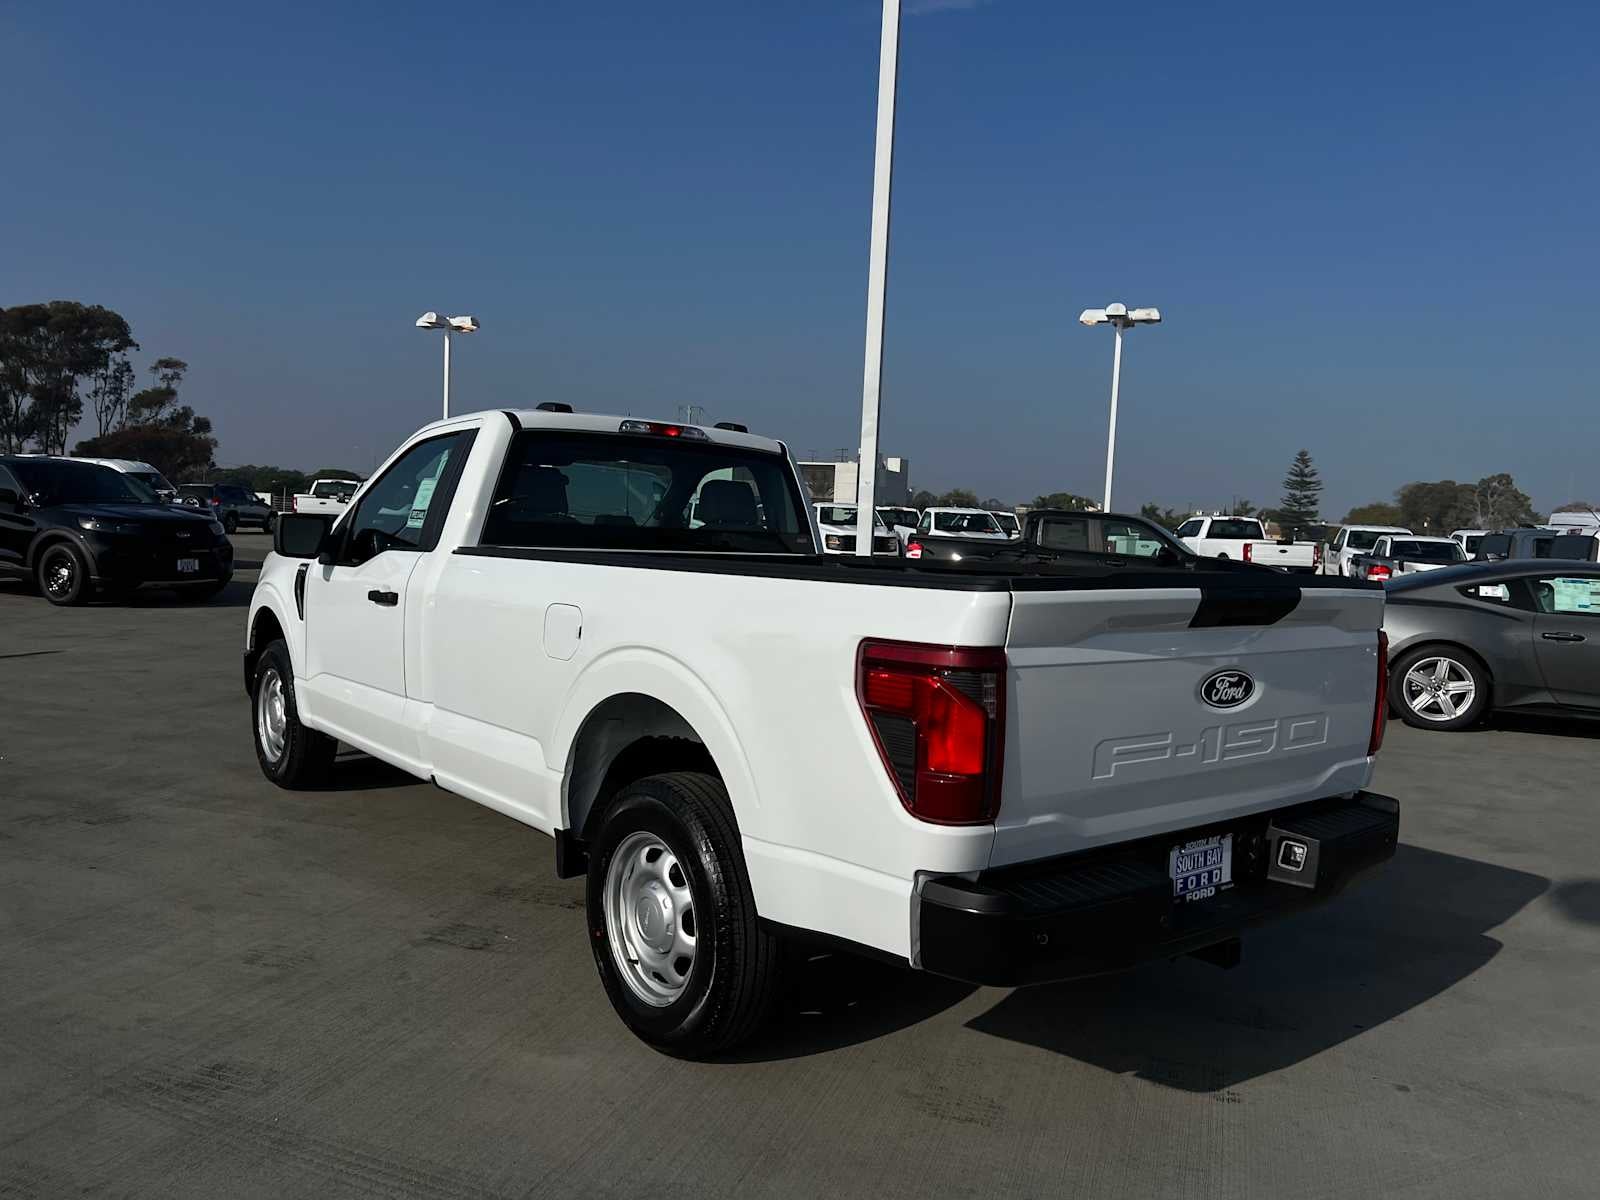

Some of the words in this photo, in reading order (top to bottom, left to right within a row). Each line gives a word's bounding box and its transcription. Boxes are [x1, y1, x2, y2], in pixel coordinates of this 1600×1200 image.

[1211, 676, 1247, 702] Ford
[1091, 711, 1329, 780] F-150
[1177, 852, 1205, 873] SOUTH
[1206, 847, 1223, 867] BAY
[1176, 869, 1221, 894] FORD
[1186, 886, 1216, 903] FORD
